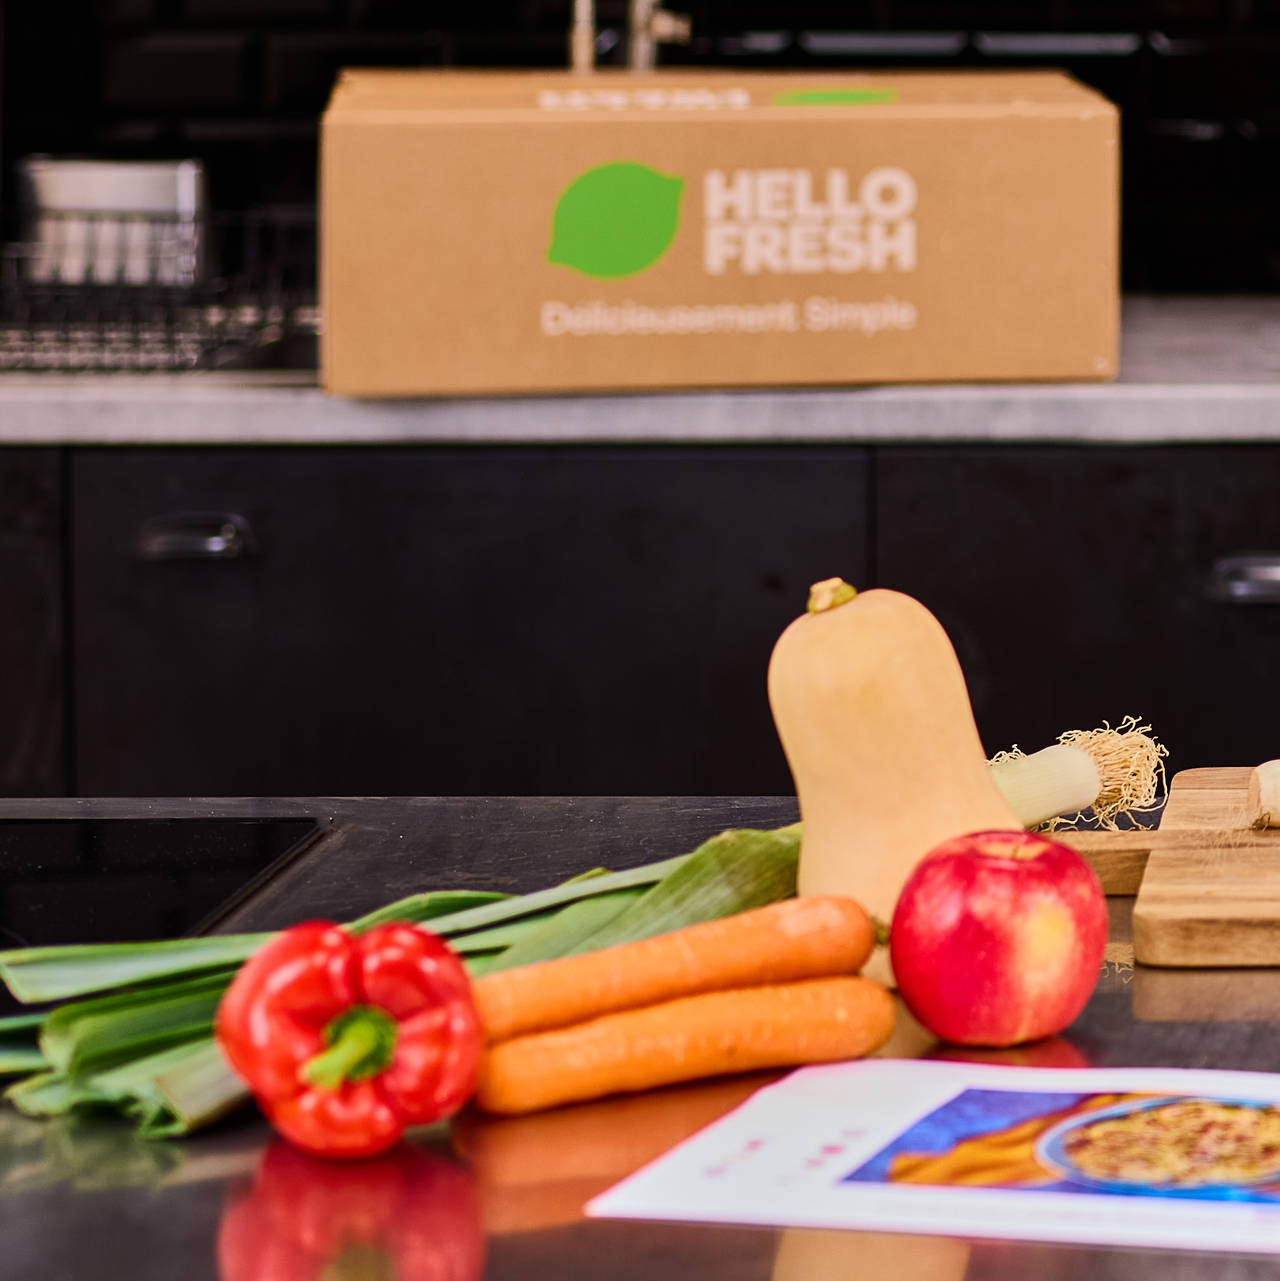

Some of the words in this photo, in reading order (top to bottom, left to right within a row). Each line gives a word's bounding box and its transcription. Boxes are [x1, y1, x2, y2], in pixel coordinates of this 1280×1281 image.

[704, 166, 918, 221] HELLO
[704, 219, 917, 276] FRESH
[804, 294, 917, 337] Simple
